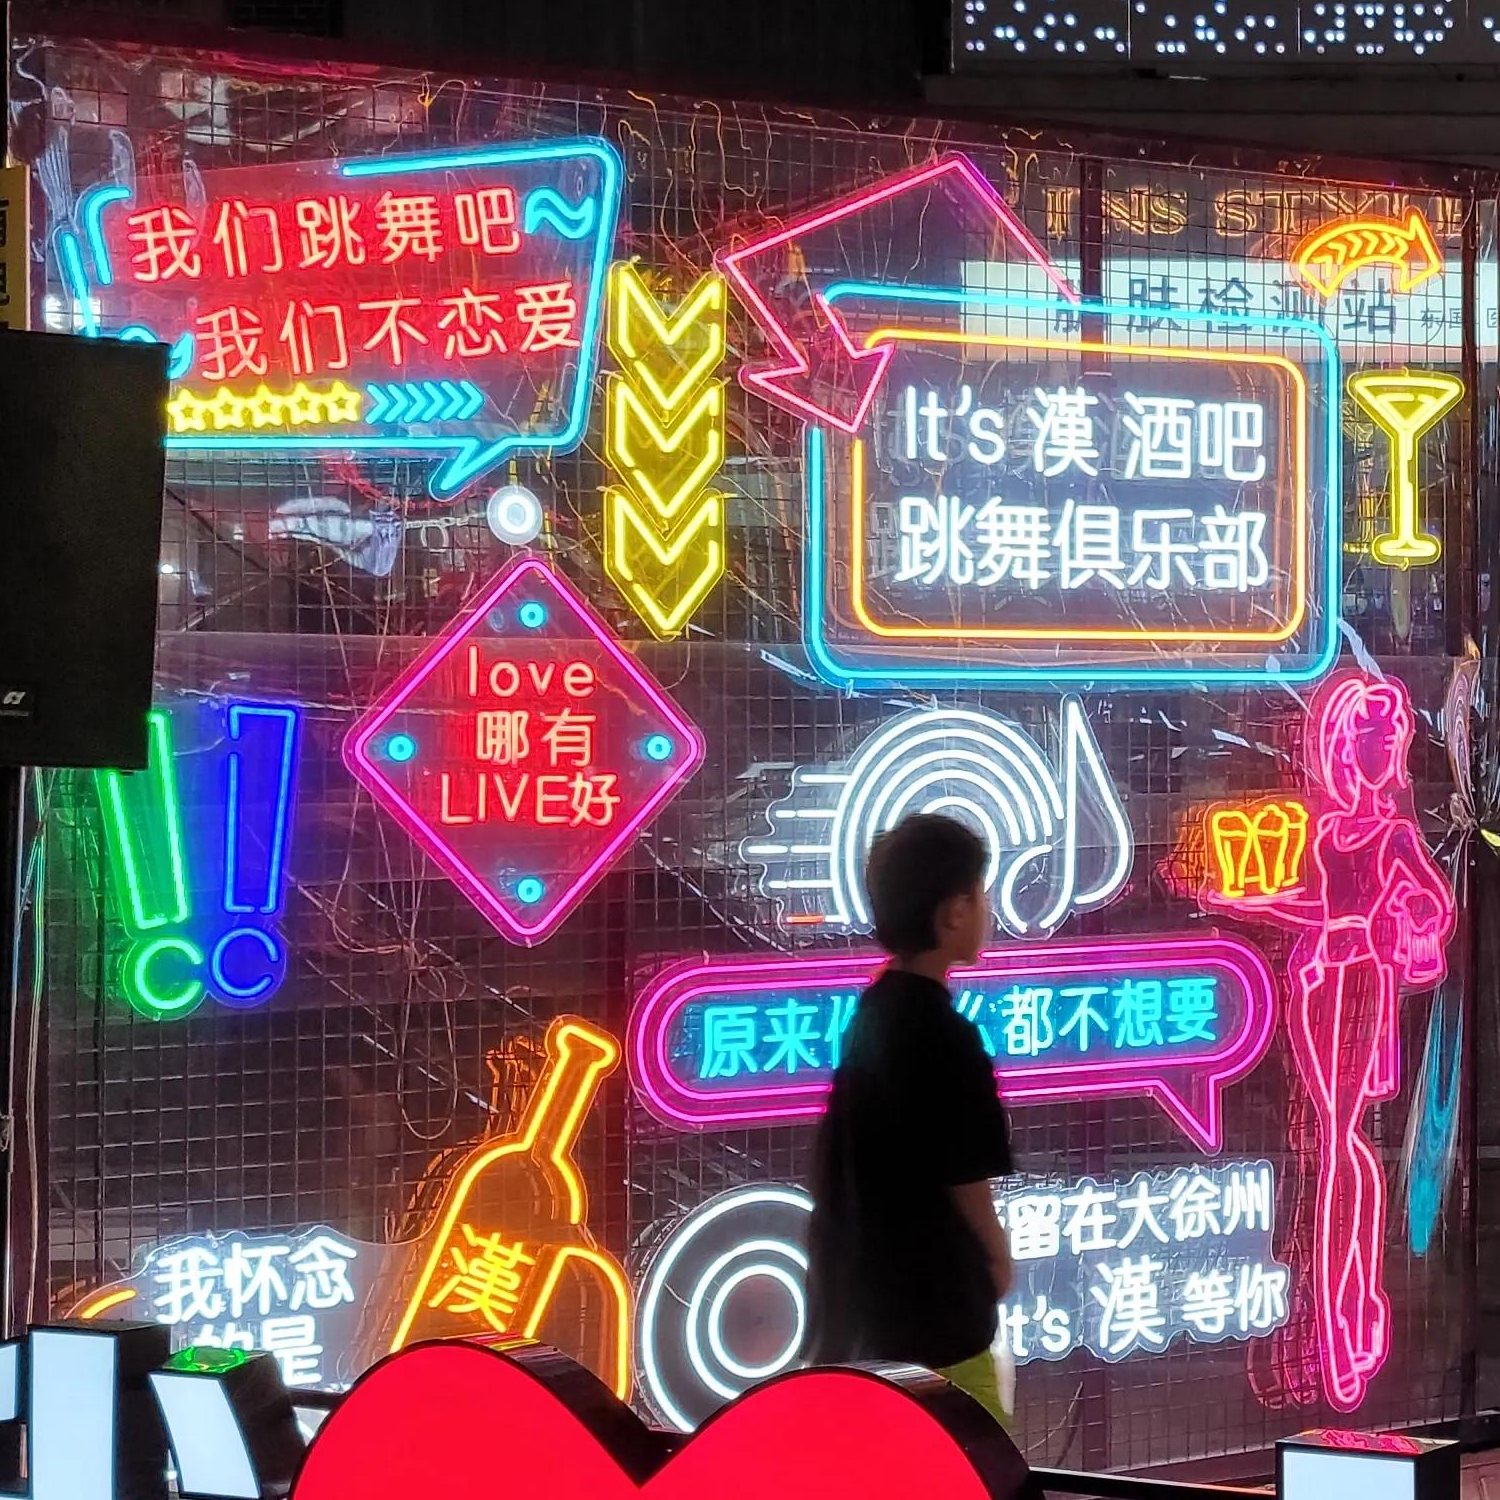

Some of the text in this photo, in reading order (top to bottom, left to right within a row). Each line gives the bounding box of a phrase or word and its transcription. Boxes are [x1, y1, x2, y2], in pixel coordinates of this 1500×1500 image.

[126, 187, 521, 282] 我们跳舞吧
[195, 280, 582, 382] 我们不恋爱
[903, 386, 1267, 483] It's 漢 酒吧
[897, 496, 1270, 594] 跳舞俱乐部
[467, 645, 597, 700] love
[475, 707, 599, 769] 哪有
[440, 773, 621, 827] LIVE好
[993, 1167, 1270, 1261] 留在大徐州
[153, 1235, 358, 1325] 我怀念
[1089, 1254, 1166, 1355] 漢
[1180, 1262, 1286, 1334] 等你
